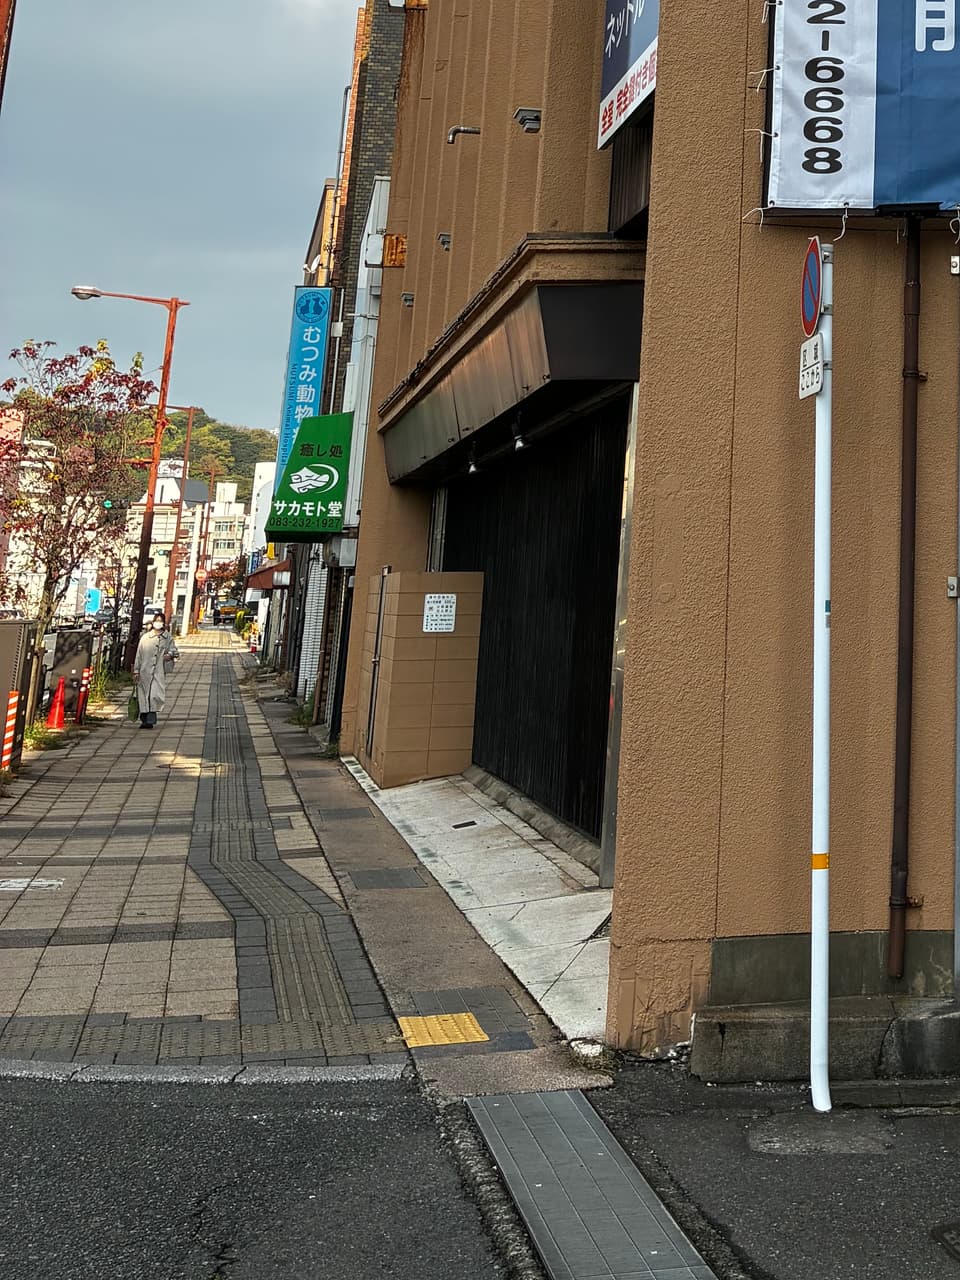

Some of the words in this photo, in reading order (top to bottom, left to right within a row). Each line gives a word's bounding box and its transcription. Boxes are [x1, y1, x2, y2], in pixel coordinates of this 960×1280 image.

[292, 326, 322, 443] むつみ動物
[300, 443, 344, 458] 癒し処
[273, 500, 343, 517] サカモト堂
